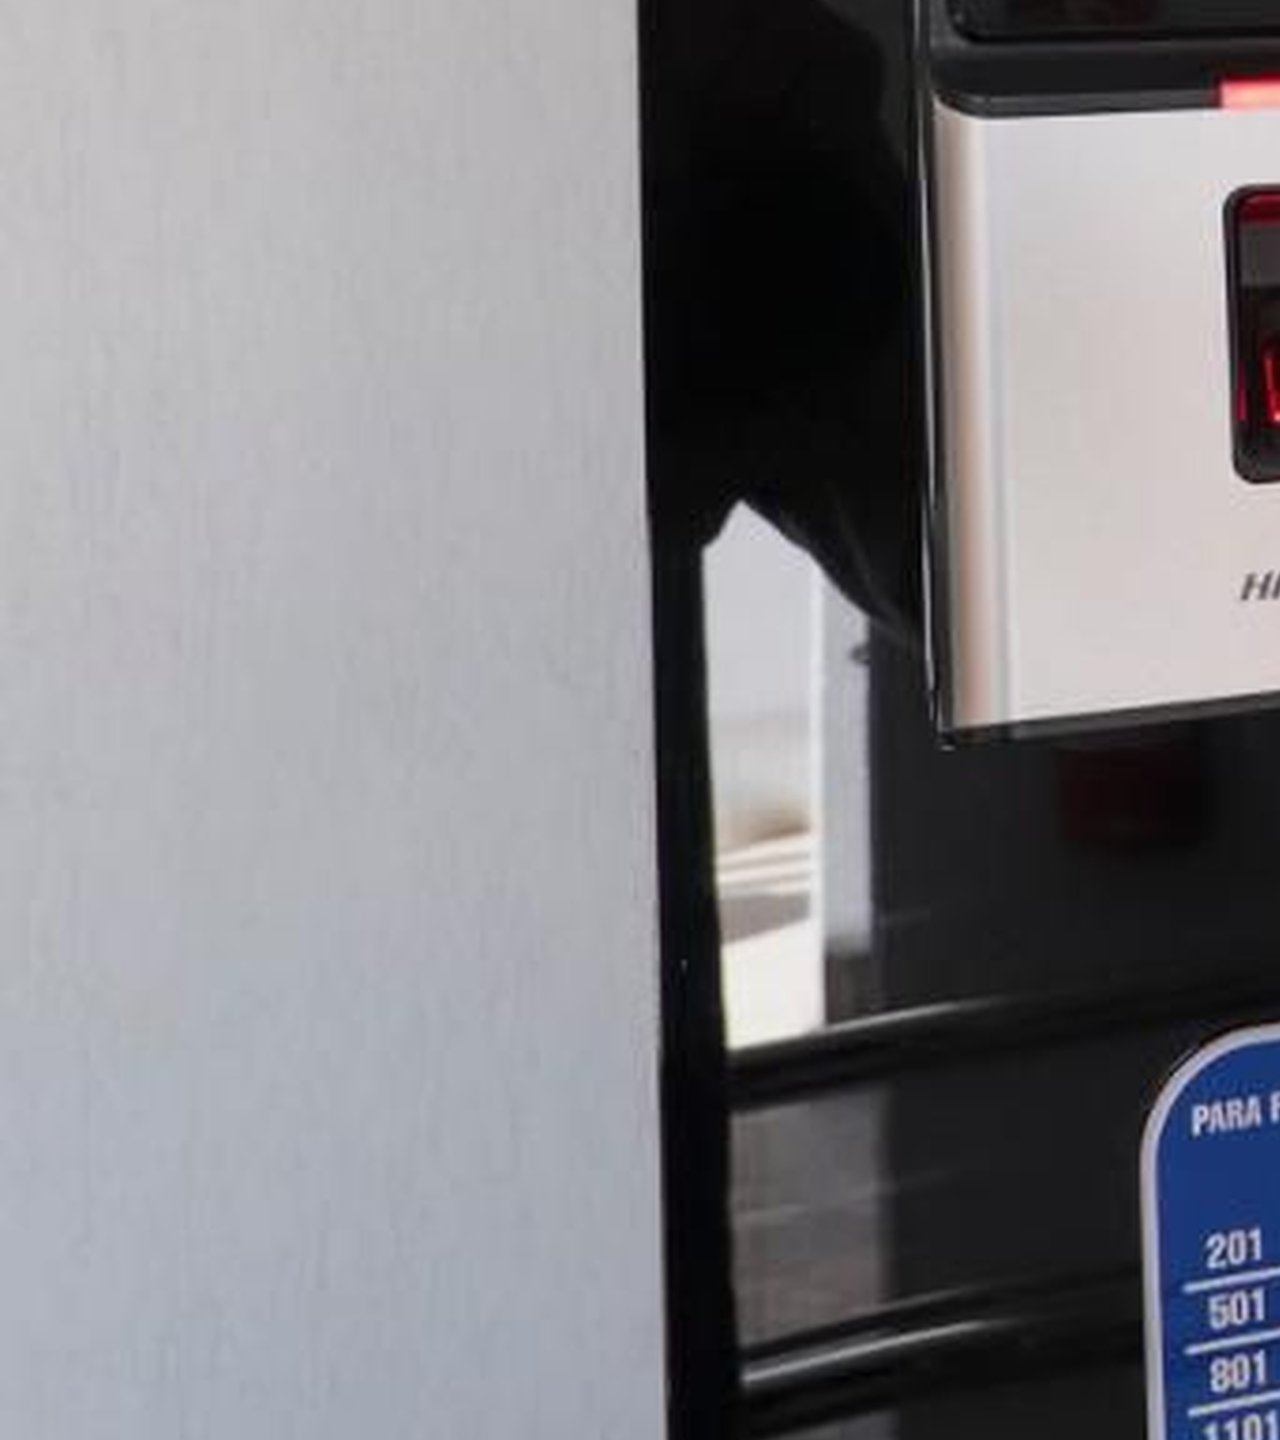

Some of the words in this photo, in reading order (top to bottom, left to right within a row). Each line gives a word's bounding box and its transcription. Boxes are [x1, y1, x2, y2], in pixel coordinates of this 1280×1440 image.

[1193, 1097, 1262, 1135] PARA
[1205, 1232, 1263, 1270] 201
[1207, 1291, 1266, 1330] 501
[1210, 1352, 1269, 1391] 801
